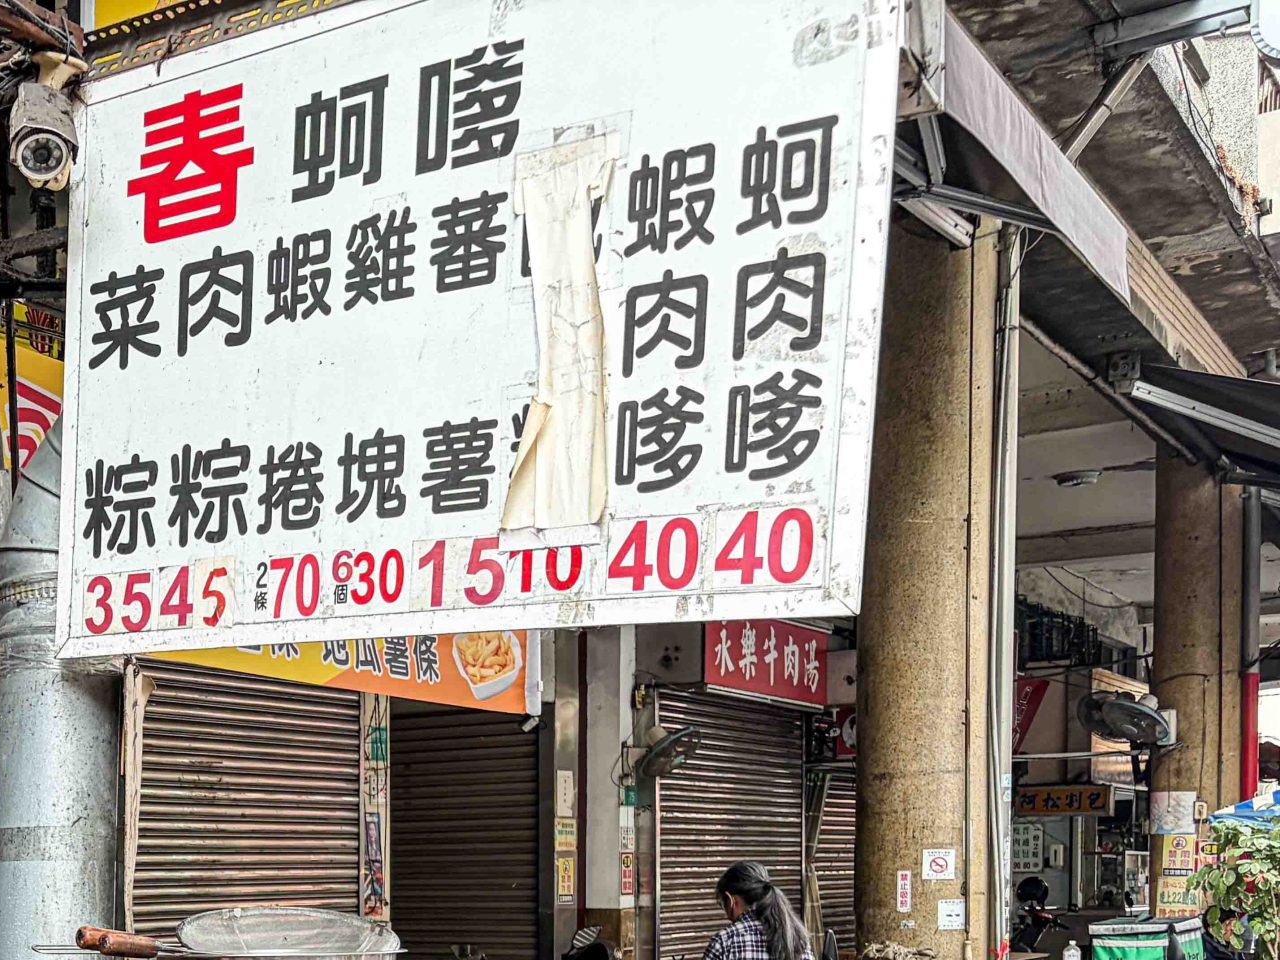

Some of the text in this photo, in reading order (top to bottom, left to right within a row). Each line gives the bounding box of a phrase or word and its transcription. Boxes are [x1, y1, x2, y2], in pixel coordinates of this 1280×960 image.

[127, 39, 526, 244] 春 蚵嗲
[615, 143, 716, 494] 蝦肉嗲
[724, 114, 839, 482] 蚵肉嗲
[351, 548, 405, 606] 30
[418, 537, 505, 608] 15
[608, 517, 700, 592] 40
[714, 508, 814, 585] 40
[85, 572, 151, 634] 35
[159, 566, 228, 628] 45
[269, 556, 320, 619] 70
[714, 620, 820, 694] 永樂牛肉湯
